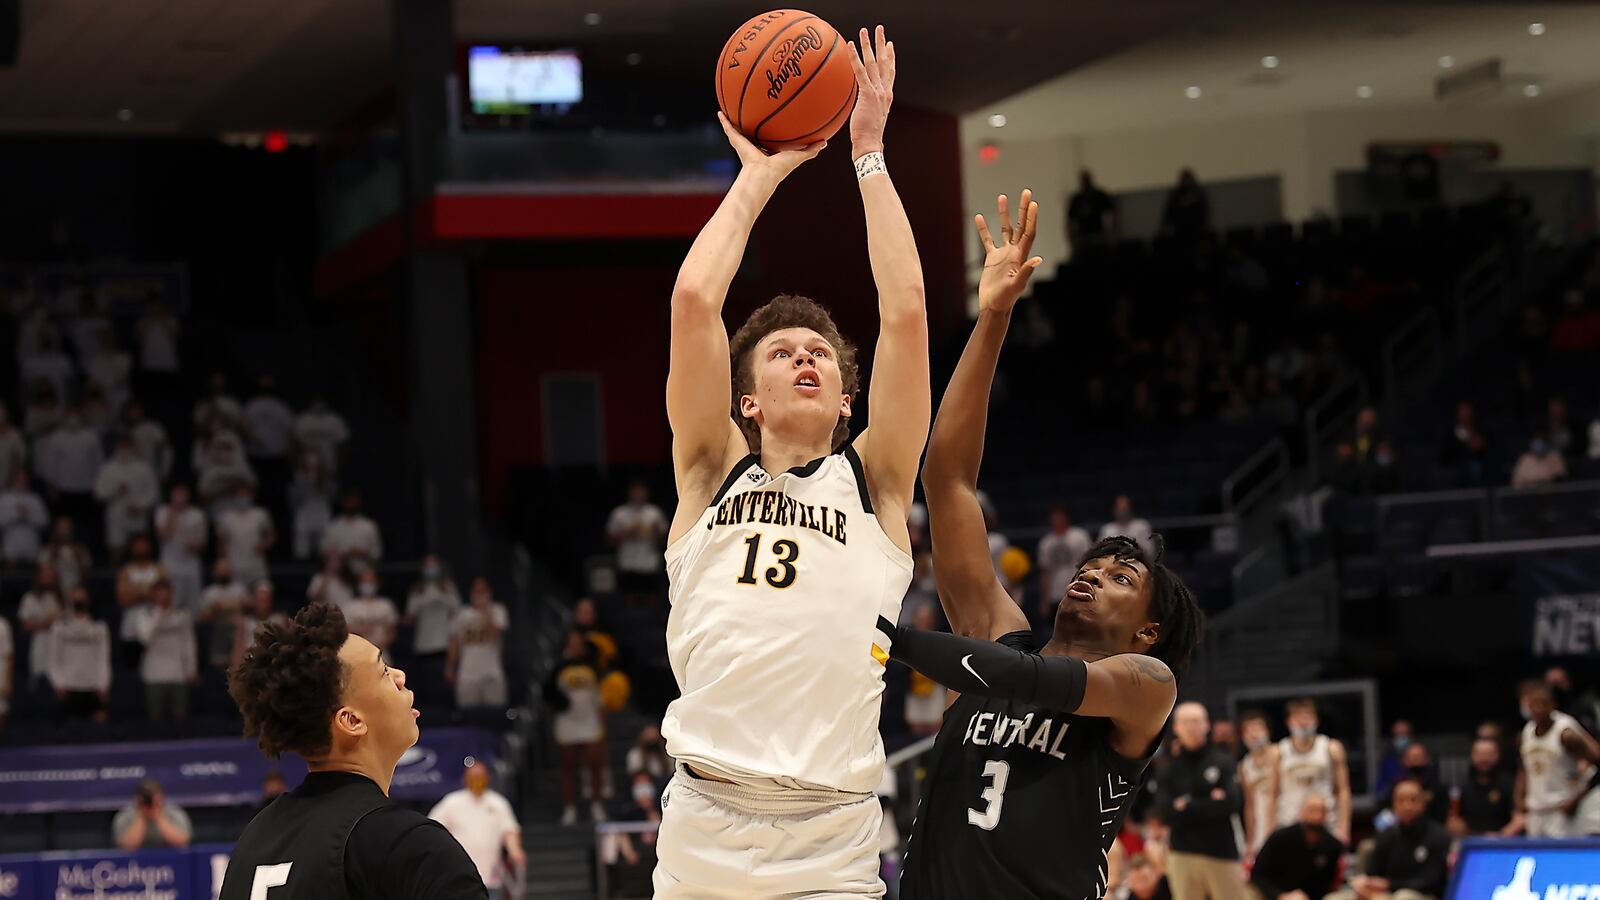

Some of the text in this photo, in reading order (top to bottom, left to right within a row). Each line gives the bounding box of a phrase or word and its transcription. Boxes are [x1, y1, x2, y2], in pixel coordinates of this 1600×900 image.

[728, 11, 785, 69] OHSAA
[766, 25, 822, 100] Rawlings
[736, 532, 800, 589] 13
[1533, 613, 1600, 656] NE
[967, 760, 1010, 831] 3
